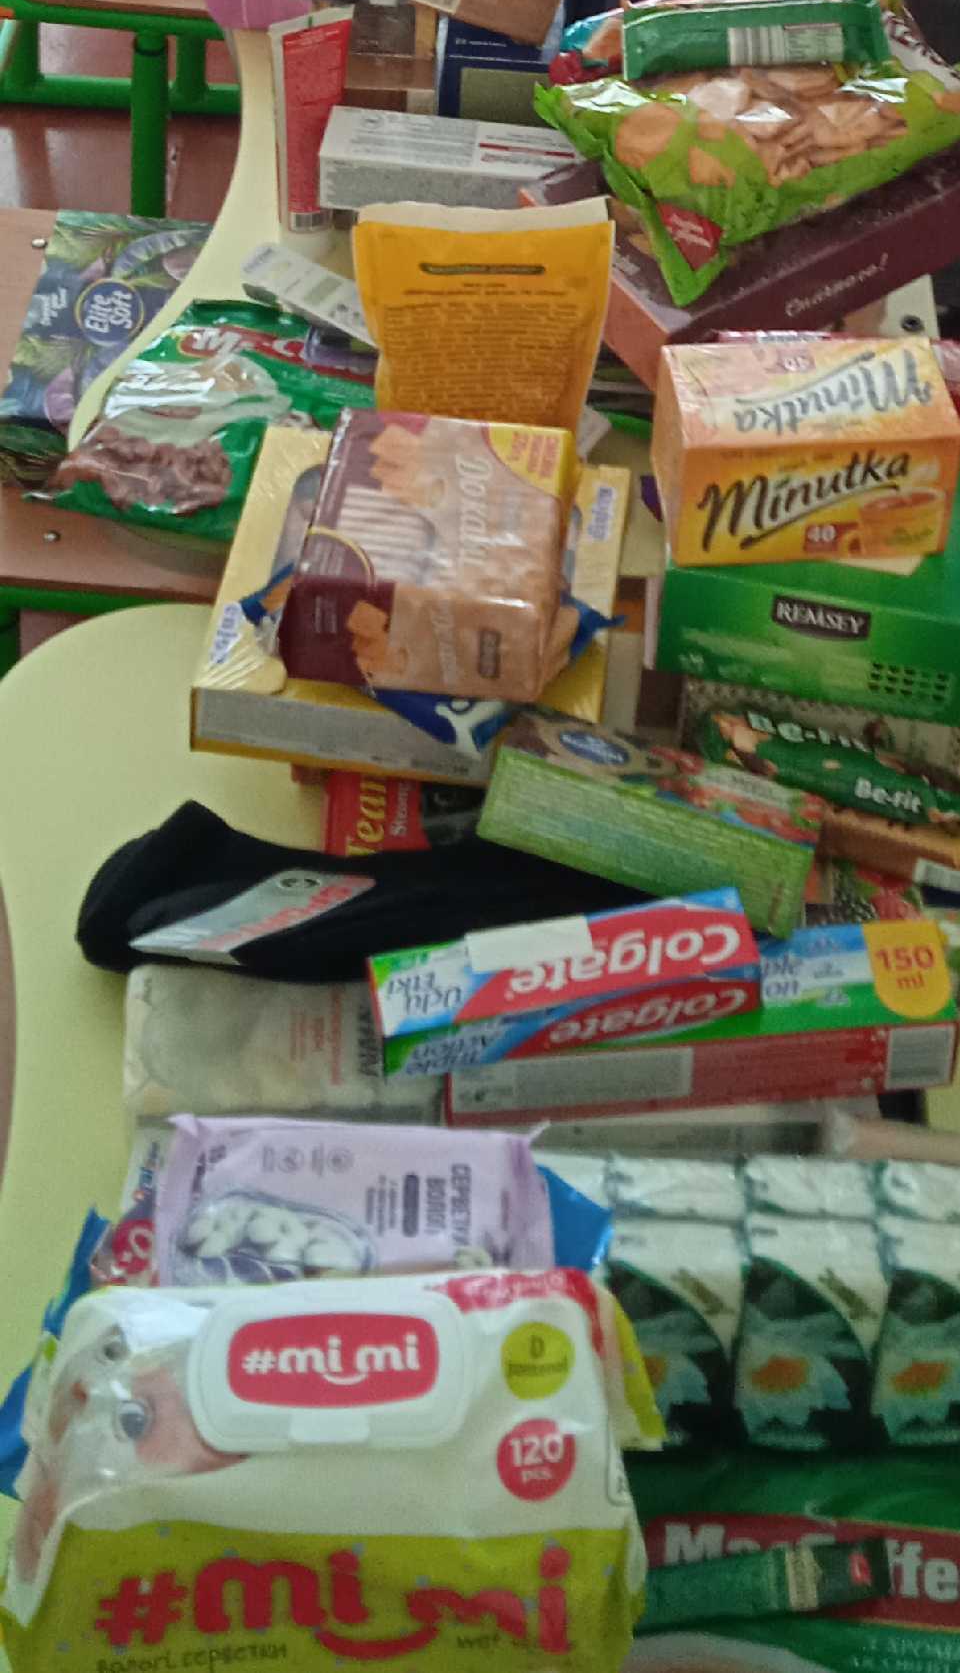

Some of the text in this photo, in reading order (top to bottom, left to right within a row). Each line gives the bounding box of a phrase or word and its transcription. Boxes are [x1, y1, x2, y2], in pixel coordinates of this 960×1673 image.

[732, 349, 934, 435] Minutka
[697, 449, 910, 554] Minutka
[775, 601, 867, 636] REMSEY
[508, 924, 742, 995] Colgate
[875, 944, 934, 970] 150
[894, 971, 924, 990] ml
[548, 986, 747, 1044] Colgate
[510, 1432, 564, 1467] 120
